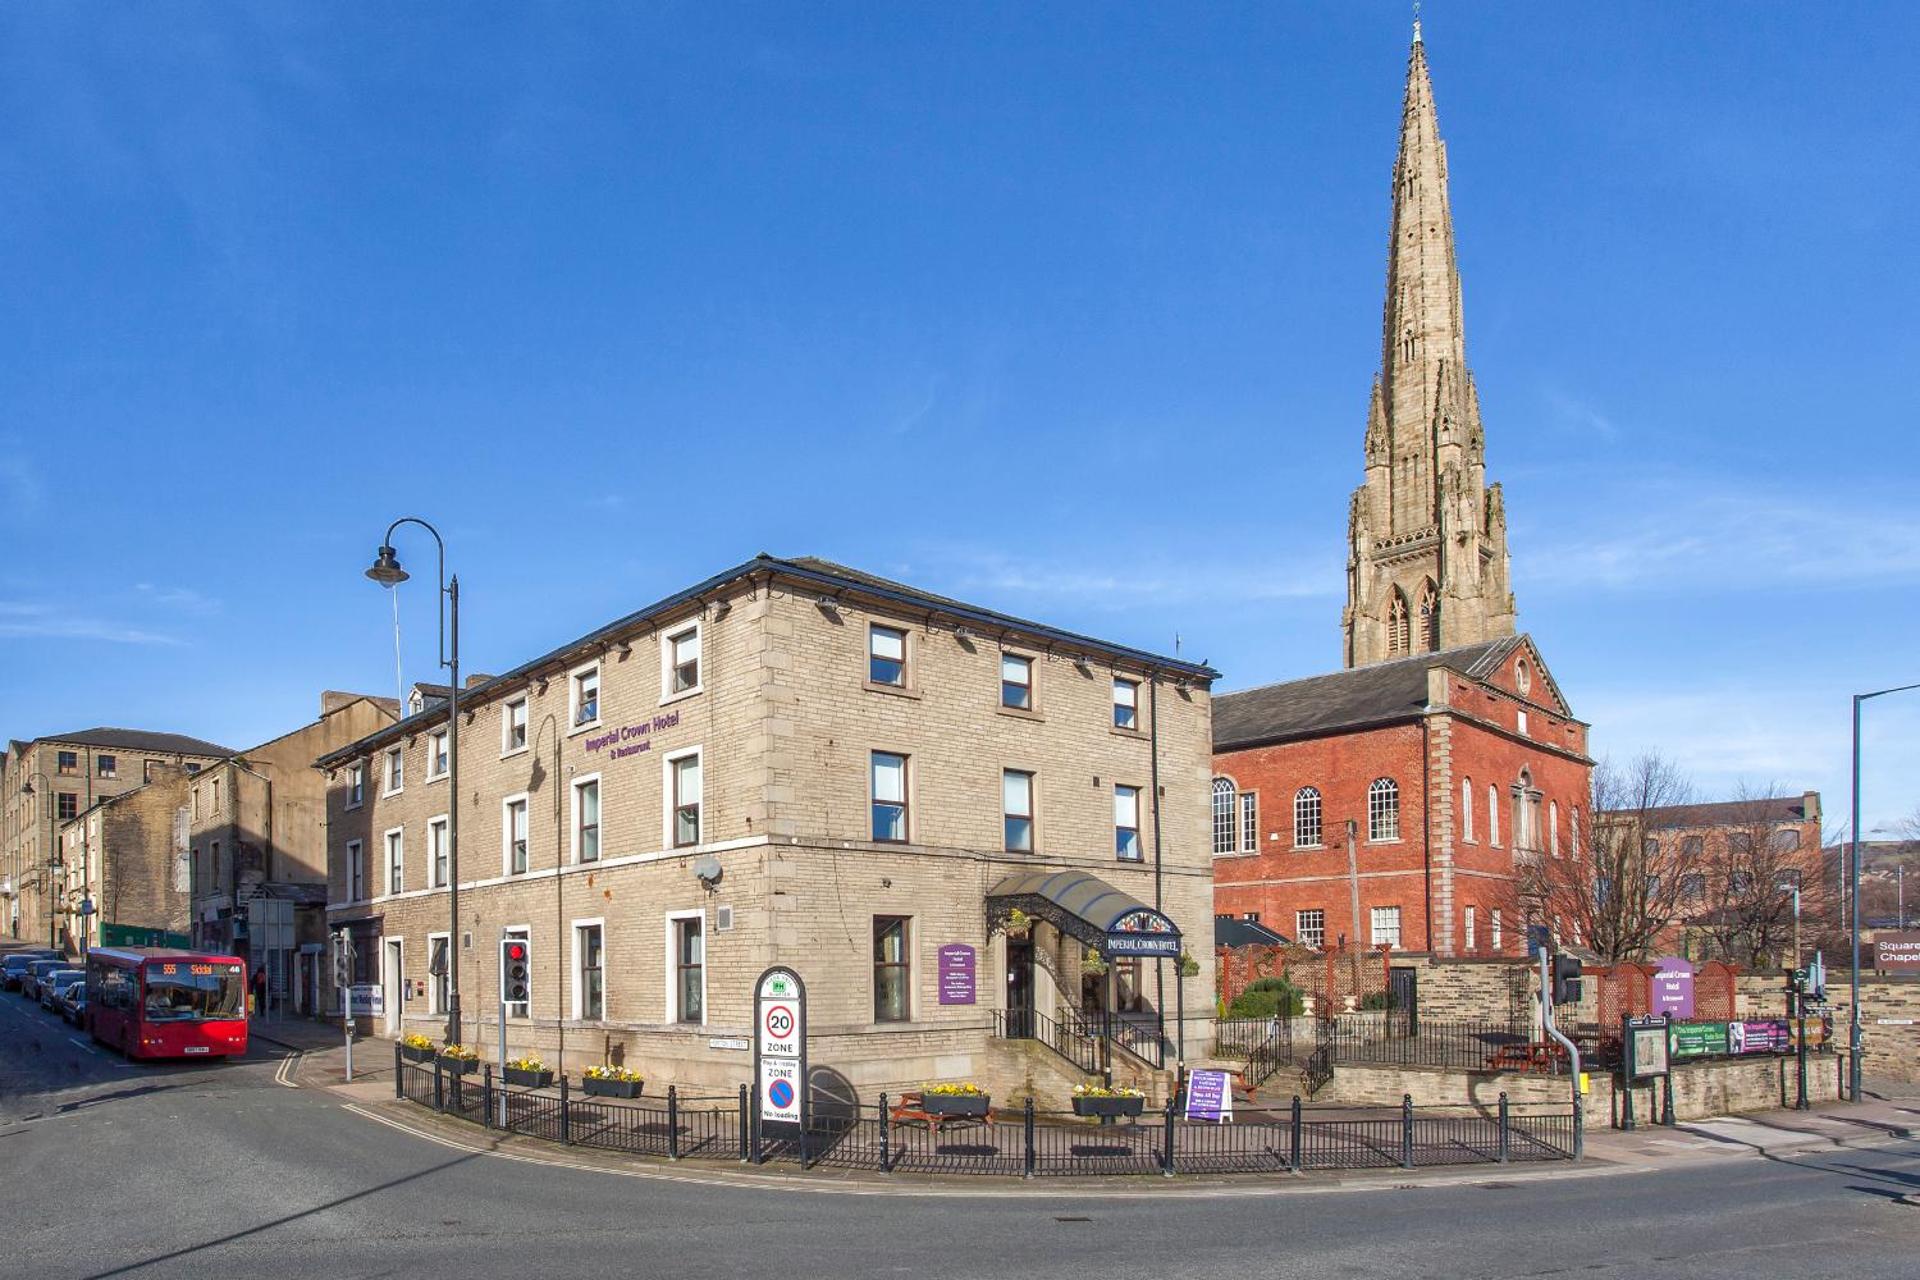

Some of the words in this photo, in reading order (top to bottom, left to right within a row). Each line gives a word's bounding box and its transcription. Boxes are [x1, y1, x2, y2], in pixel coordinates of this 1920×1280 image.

[585, 728, 619, 752] Imperial
[621, 722, 651, 741] Crown
[653, 710, 679, 732] Hotel
[1108, 939, 1137, 950] IMPERIAL
[1137, 939, 1159, 951] CROWN
[1159, 941, 1179, 952] HOTEL
[1879, 941, 1920, 953] Square
[1879, 952, 1920, 962] Chapel
[163, 964, 177, 975] 555
[771, 1015, 790, 1030] 20
[768, 1043, 793, 1053] ZONE
[768, 1069, 793, 1078] ZONE
[774, 1111, 798, 1120] loading
